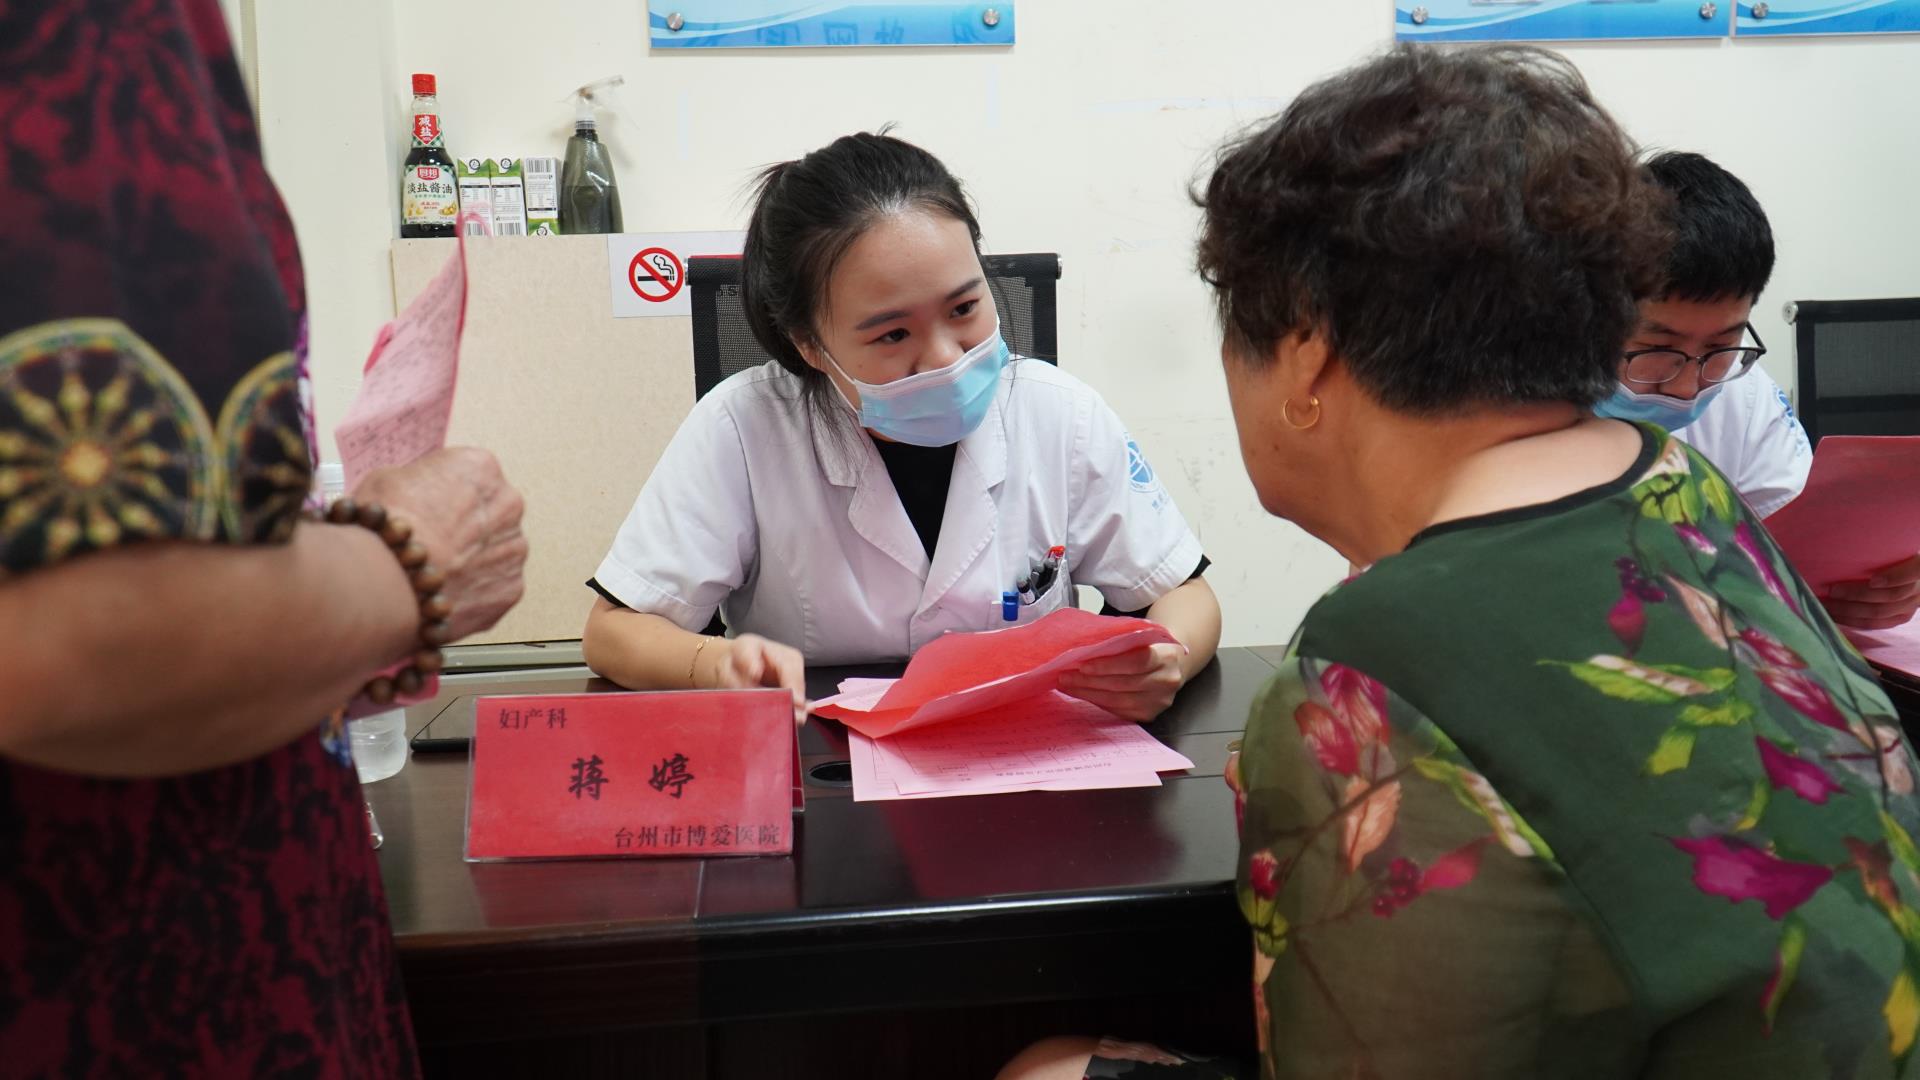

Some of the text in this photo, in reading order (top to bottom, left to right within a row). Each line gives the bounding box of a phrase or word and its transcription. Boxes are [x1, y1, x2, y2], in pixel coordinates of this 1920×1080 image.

[499, 708, 567, 729] 妇产科
[568, 753, 695, 800] 蒋婷
[614, 824, 780, 848] 台州市博爱医院
